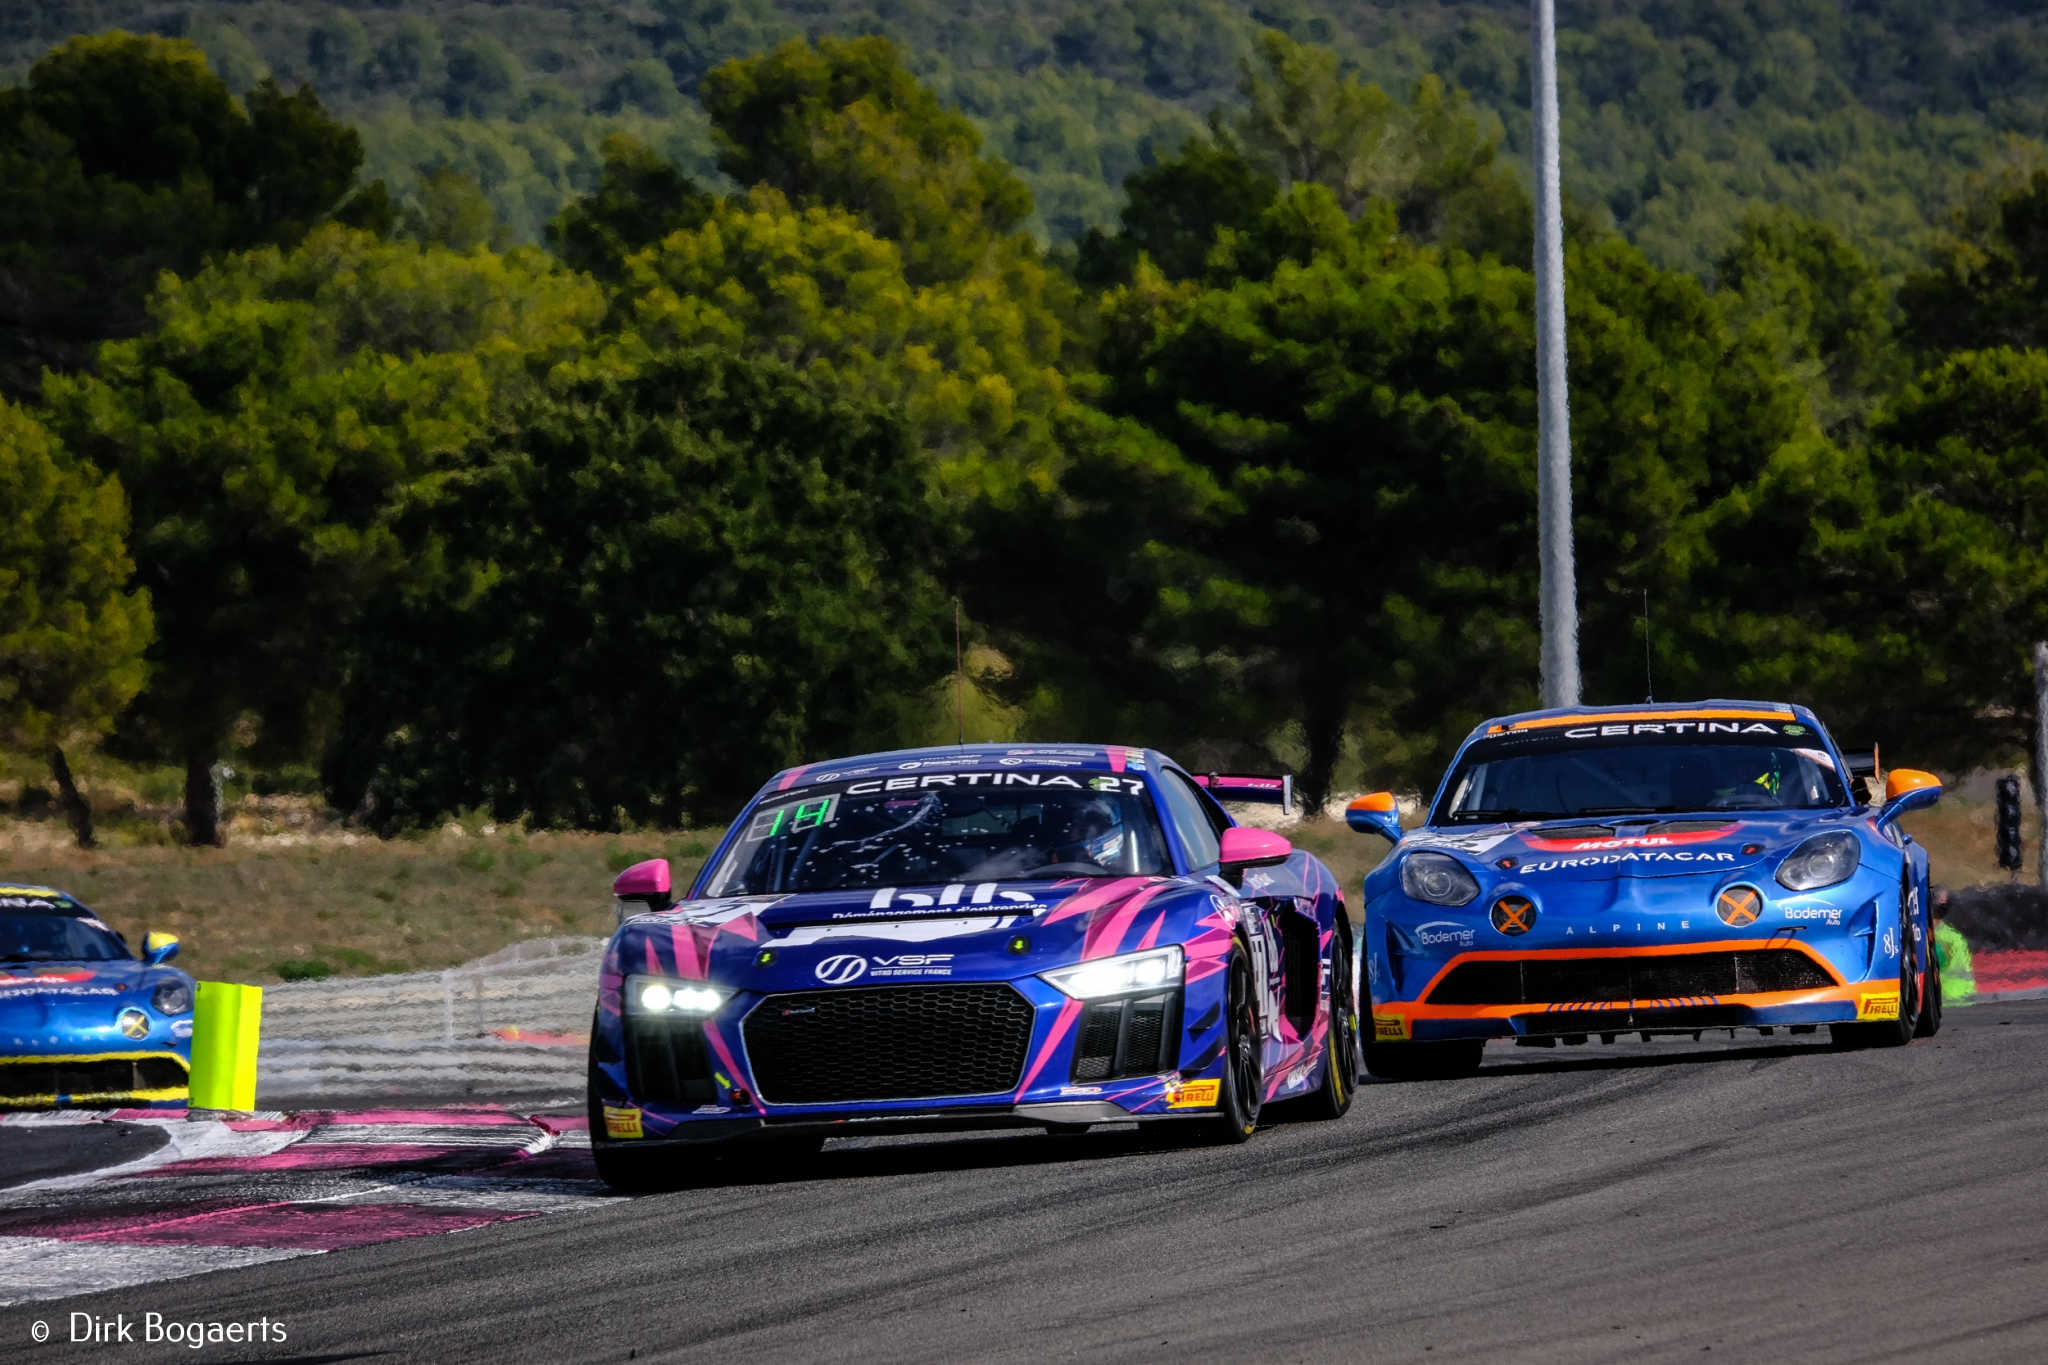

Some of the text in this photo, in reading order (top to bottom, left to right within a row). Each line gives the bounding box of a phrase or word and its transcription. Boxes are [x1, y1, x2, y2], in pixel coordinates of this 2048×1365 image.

[1565, 722, 1778, 739] CERTINA
[847, 772, 1083, 795] CERTINA
[1098, 776, 1145, 796] 27
[1572, 836, 1675, 850] MOTUL
[1520, 851, 1735, 874] EURODATACAR
[1784, 905, 1843, 919] Bodemer
[1565, 919, 1691, 936] ALPINE
[1421, 928, 1476, 945] Bodemer
[872, 953, 955, 966] VSF
[1863, 997, 1899, 1016] PIRELLI
